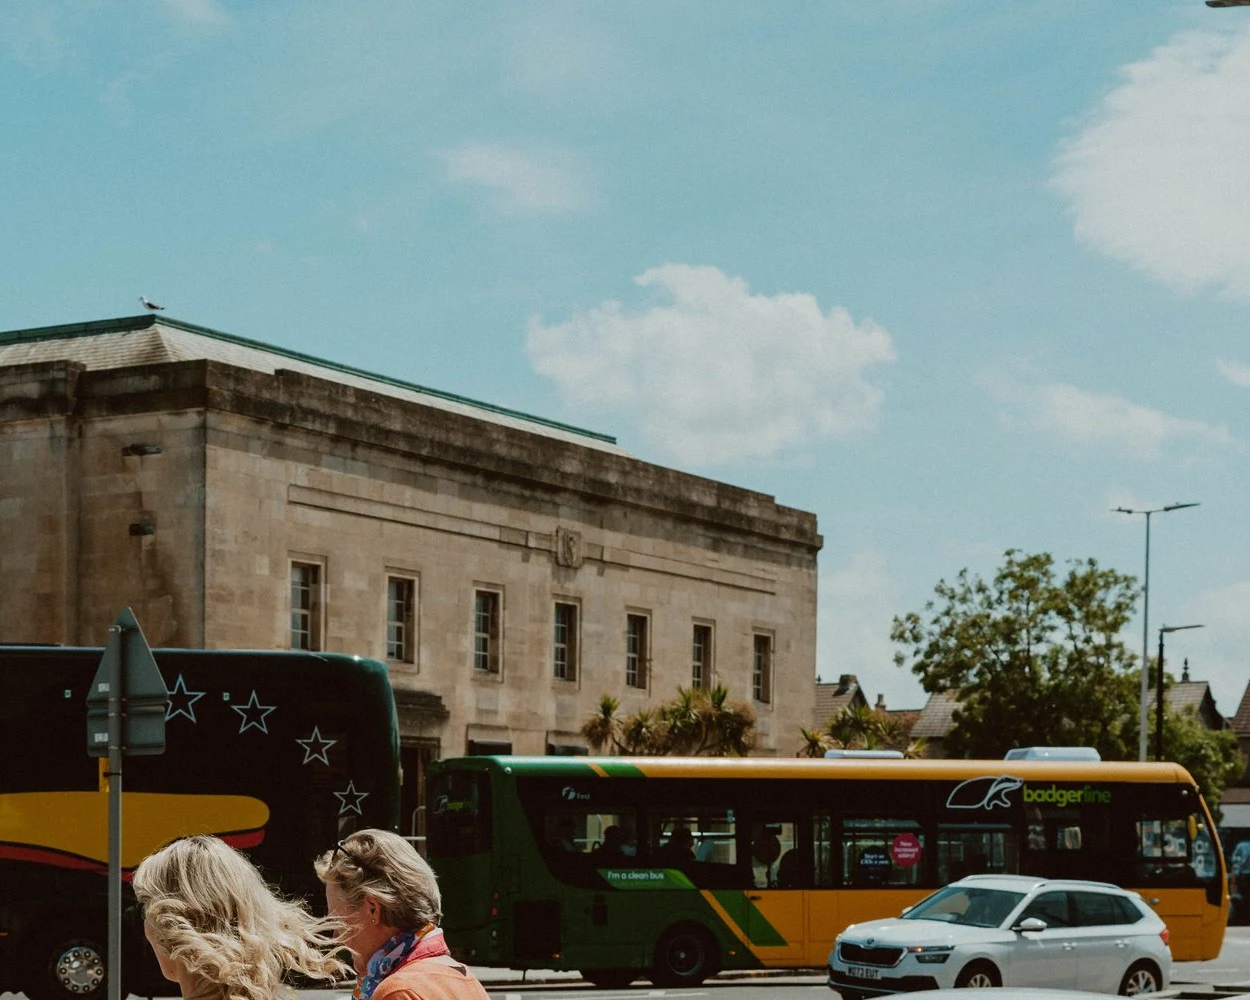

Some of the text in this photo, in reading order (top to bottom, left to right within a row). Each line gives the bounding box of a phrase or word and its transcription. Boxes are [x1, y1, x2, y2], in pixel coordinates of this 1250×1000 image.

[1023, 784, 1111, 807] badgerline
[608, 871, 619, 879] I'm
[628, 871, 649, 879] clean
[650, 871, 664, 879] bus
